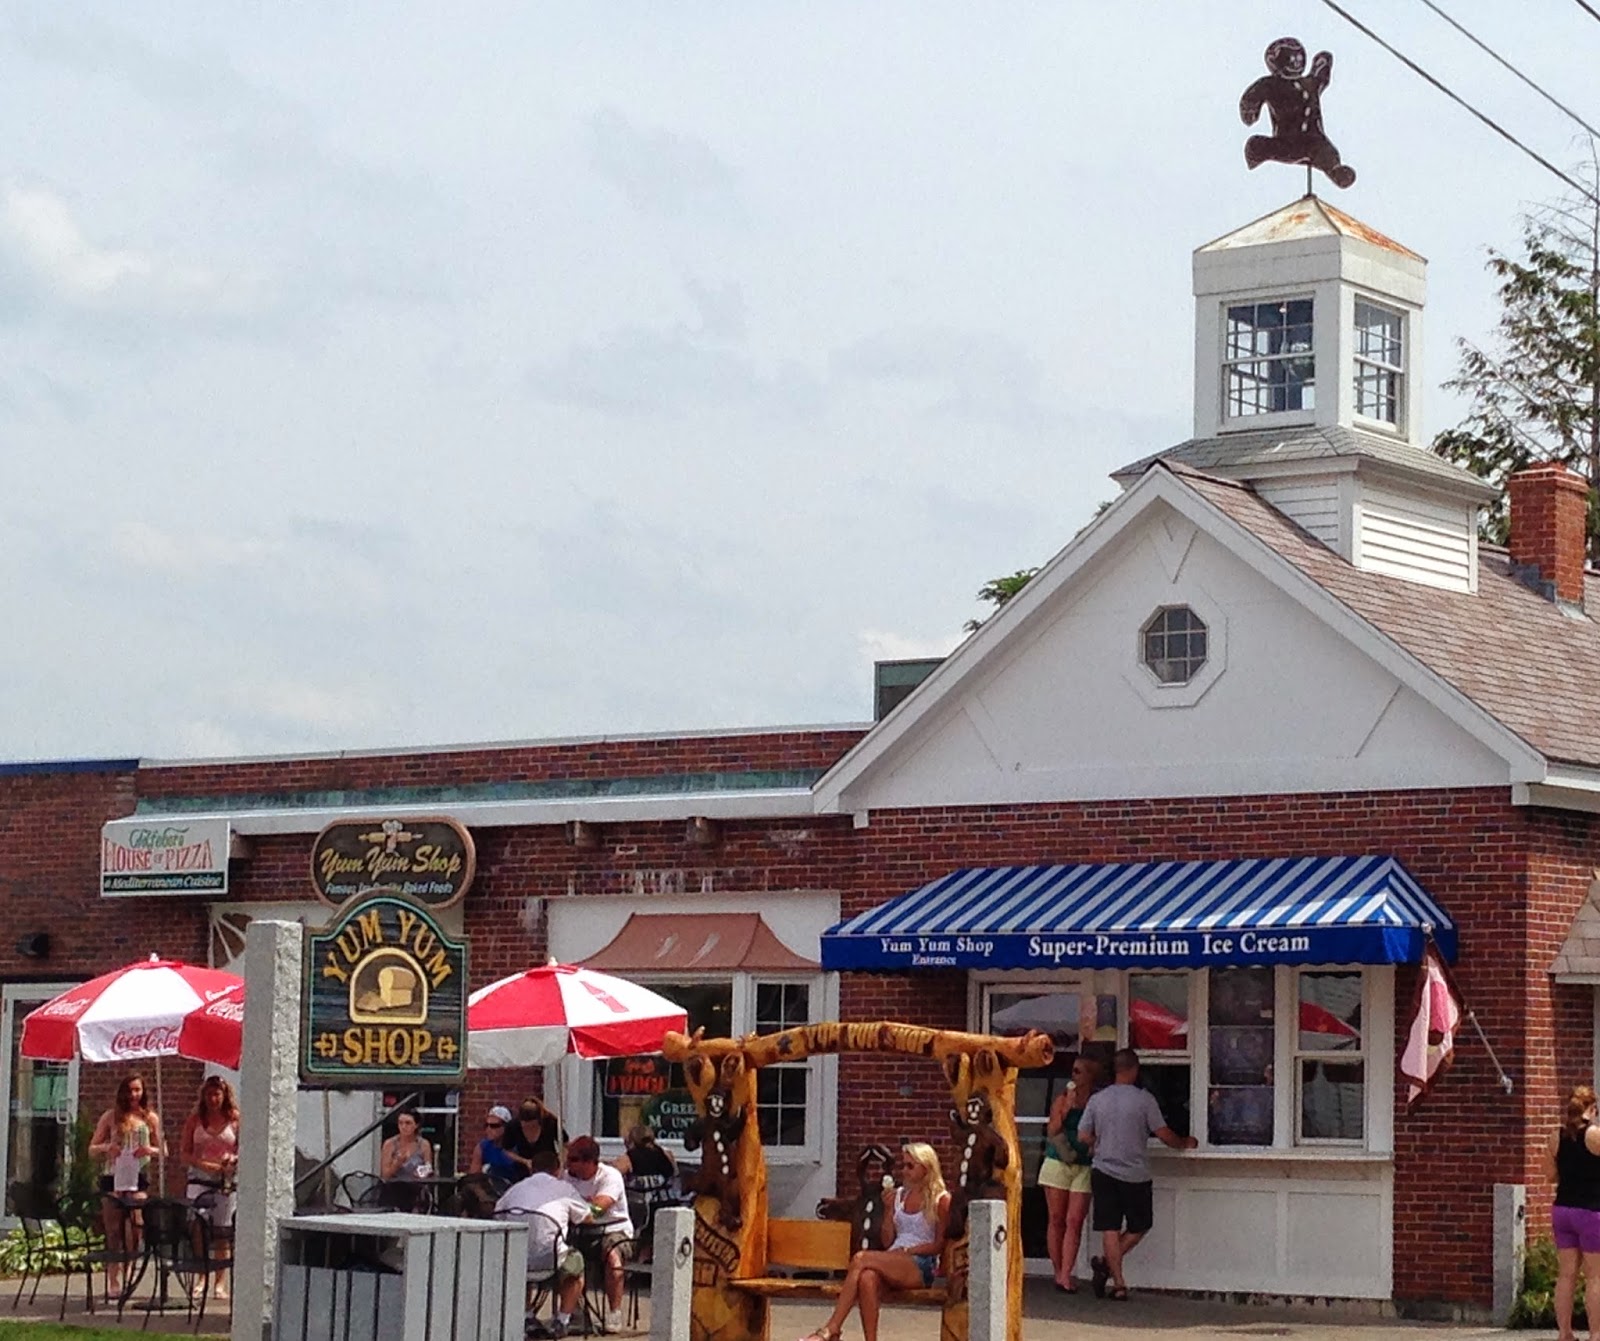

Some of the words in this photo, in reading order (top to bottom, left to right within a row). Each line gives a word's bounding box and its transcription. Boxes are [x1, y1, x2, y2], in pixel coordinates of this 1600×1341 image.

[103, 838, 152, 872] HOUSE
[164, 839, 213, 870] PIZZA
[319, 847, 364, 882] Yum
[366, 846, 410, 881] Yum
[412, 845, 462, 879] Shop
[184, 875, 222, 887] Cuisine
[403, 881, 429, 893] Baked
[322, 909, 383, 983] YUM
[397, 909, 453, 989] YUM
[880, 937, 912, 953] Yum
[918, 937, 951, 952] Yum
[956, 936, 994, 957] Shop
[1028, 934, 1190, 963] Super-Premium
[1201, 934, 1233, 955] Ice
[1240, 932, 1310, 954] Cream
[911, 954, 957, 966] Entrance
[342, 1028, 432, 1065] SHOP
[660, 1101, 698, 1114] GREE
